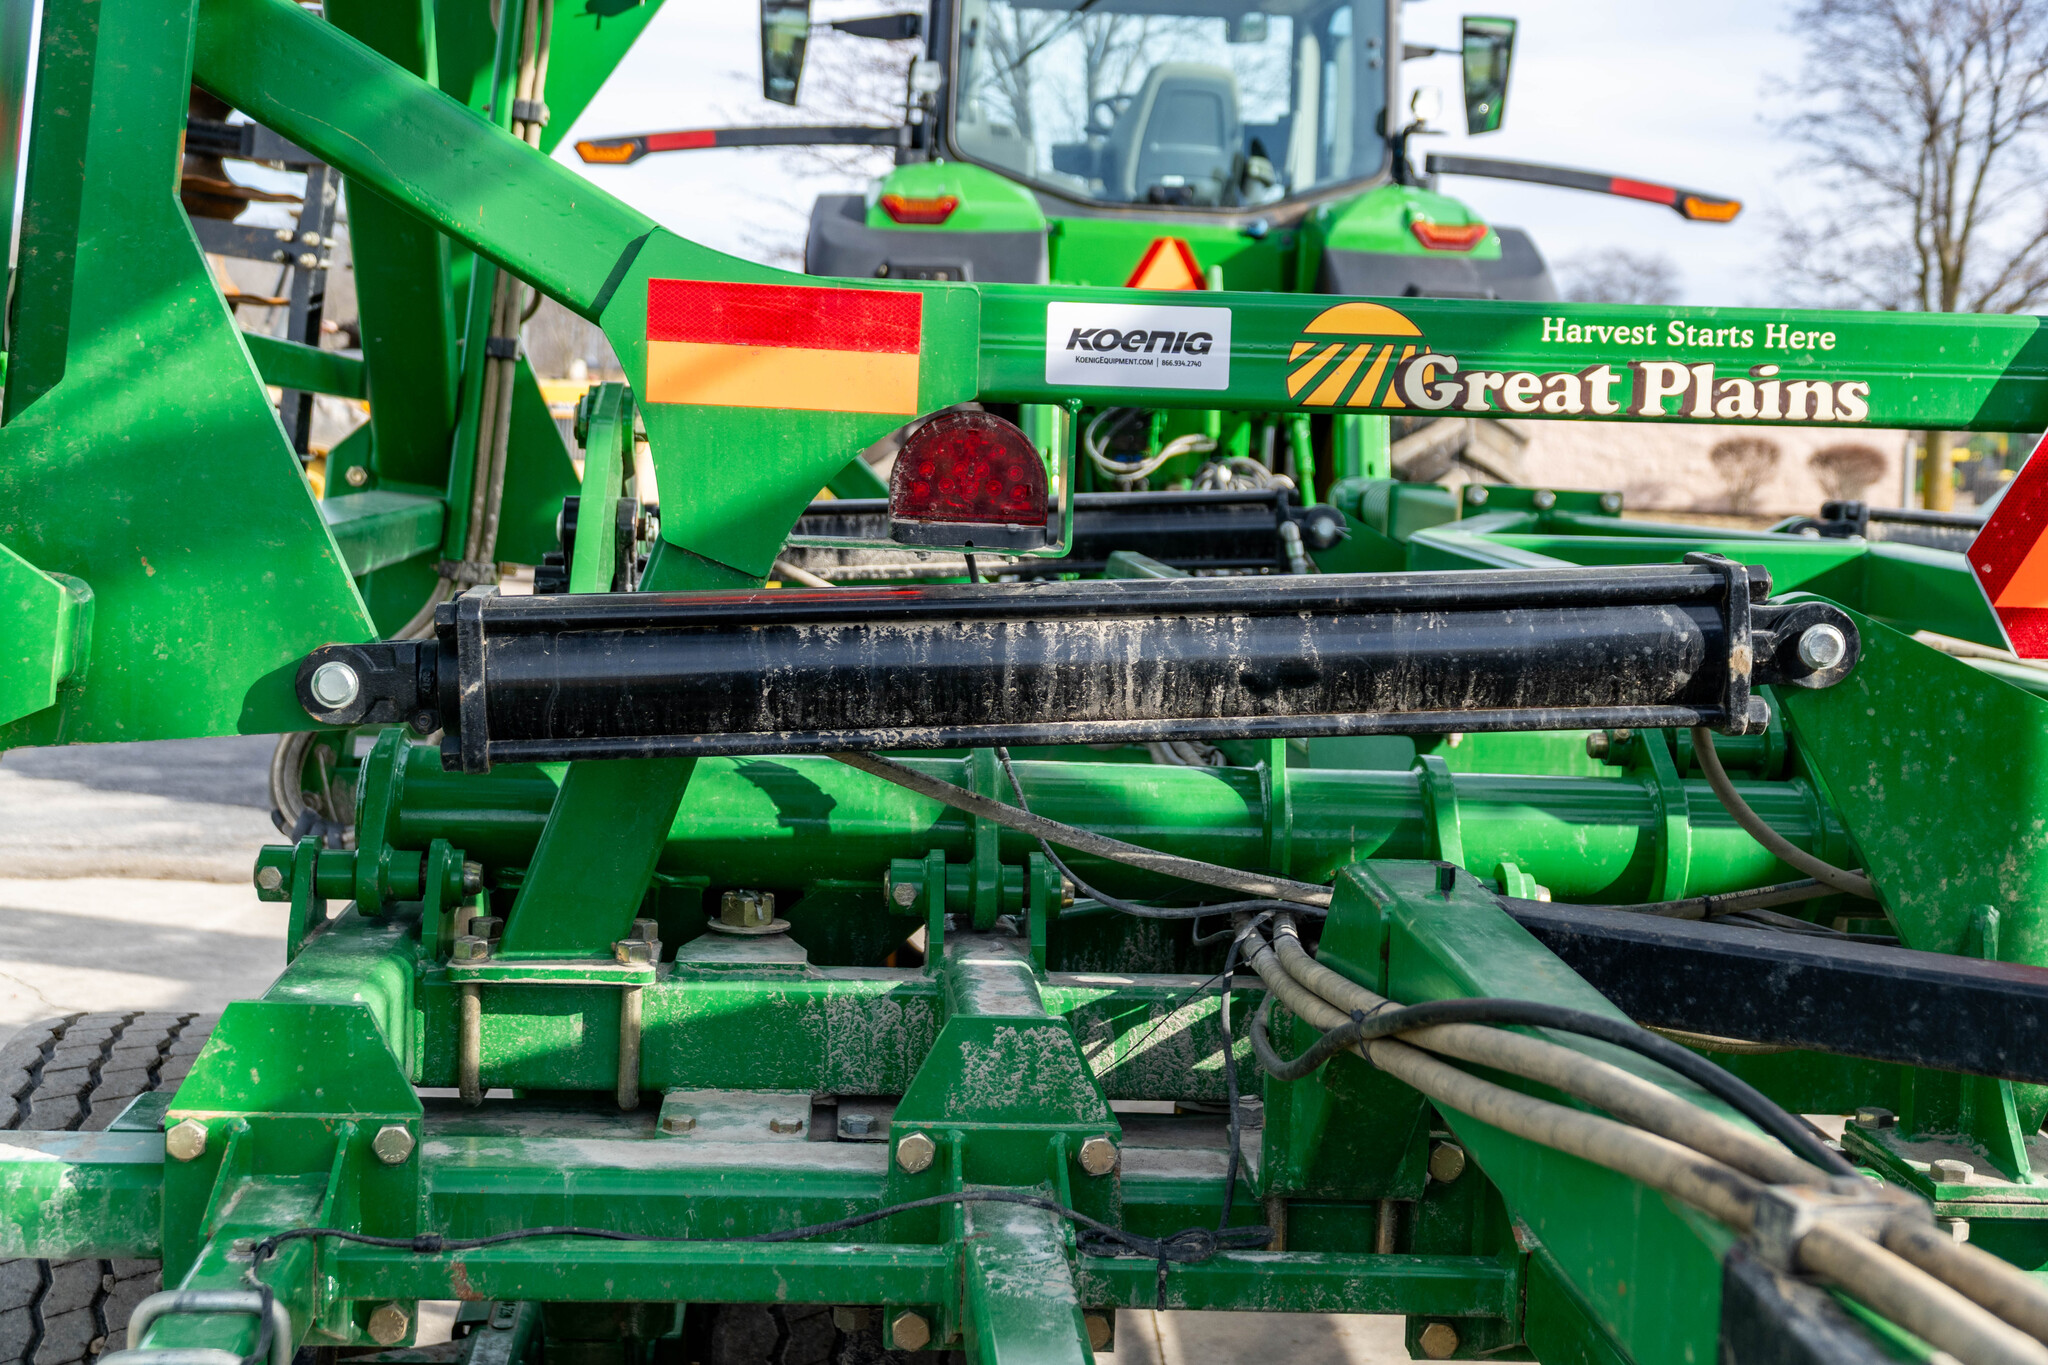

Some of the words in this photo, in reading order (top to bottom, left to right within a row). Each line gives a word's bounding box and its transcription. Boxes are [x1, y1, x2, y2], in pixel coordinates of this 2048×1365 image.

[1541, 316, 1657, 345] Harvest
[1666, 320, 1754, 348] Starts
[1764, 323, 1836, 350] Here
[1161, 359, 1202, 368] 866.934.2740
[1400, 354, 1622, 416] Great
[1633, 360, 1871, 423] Plains
